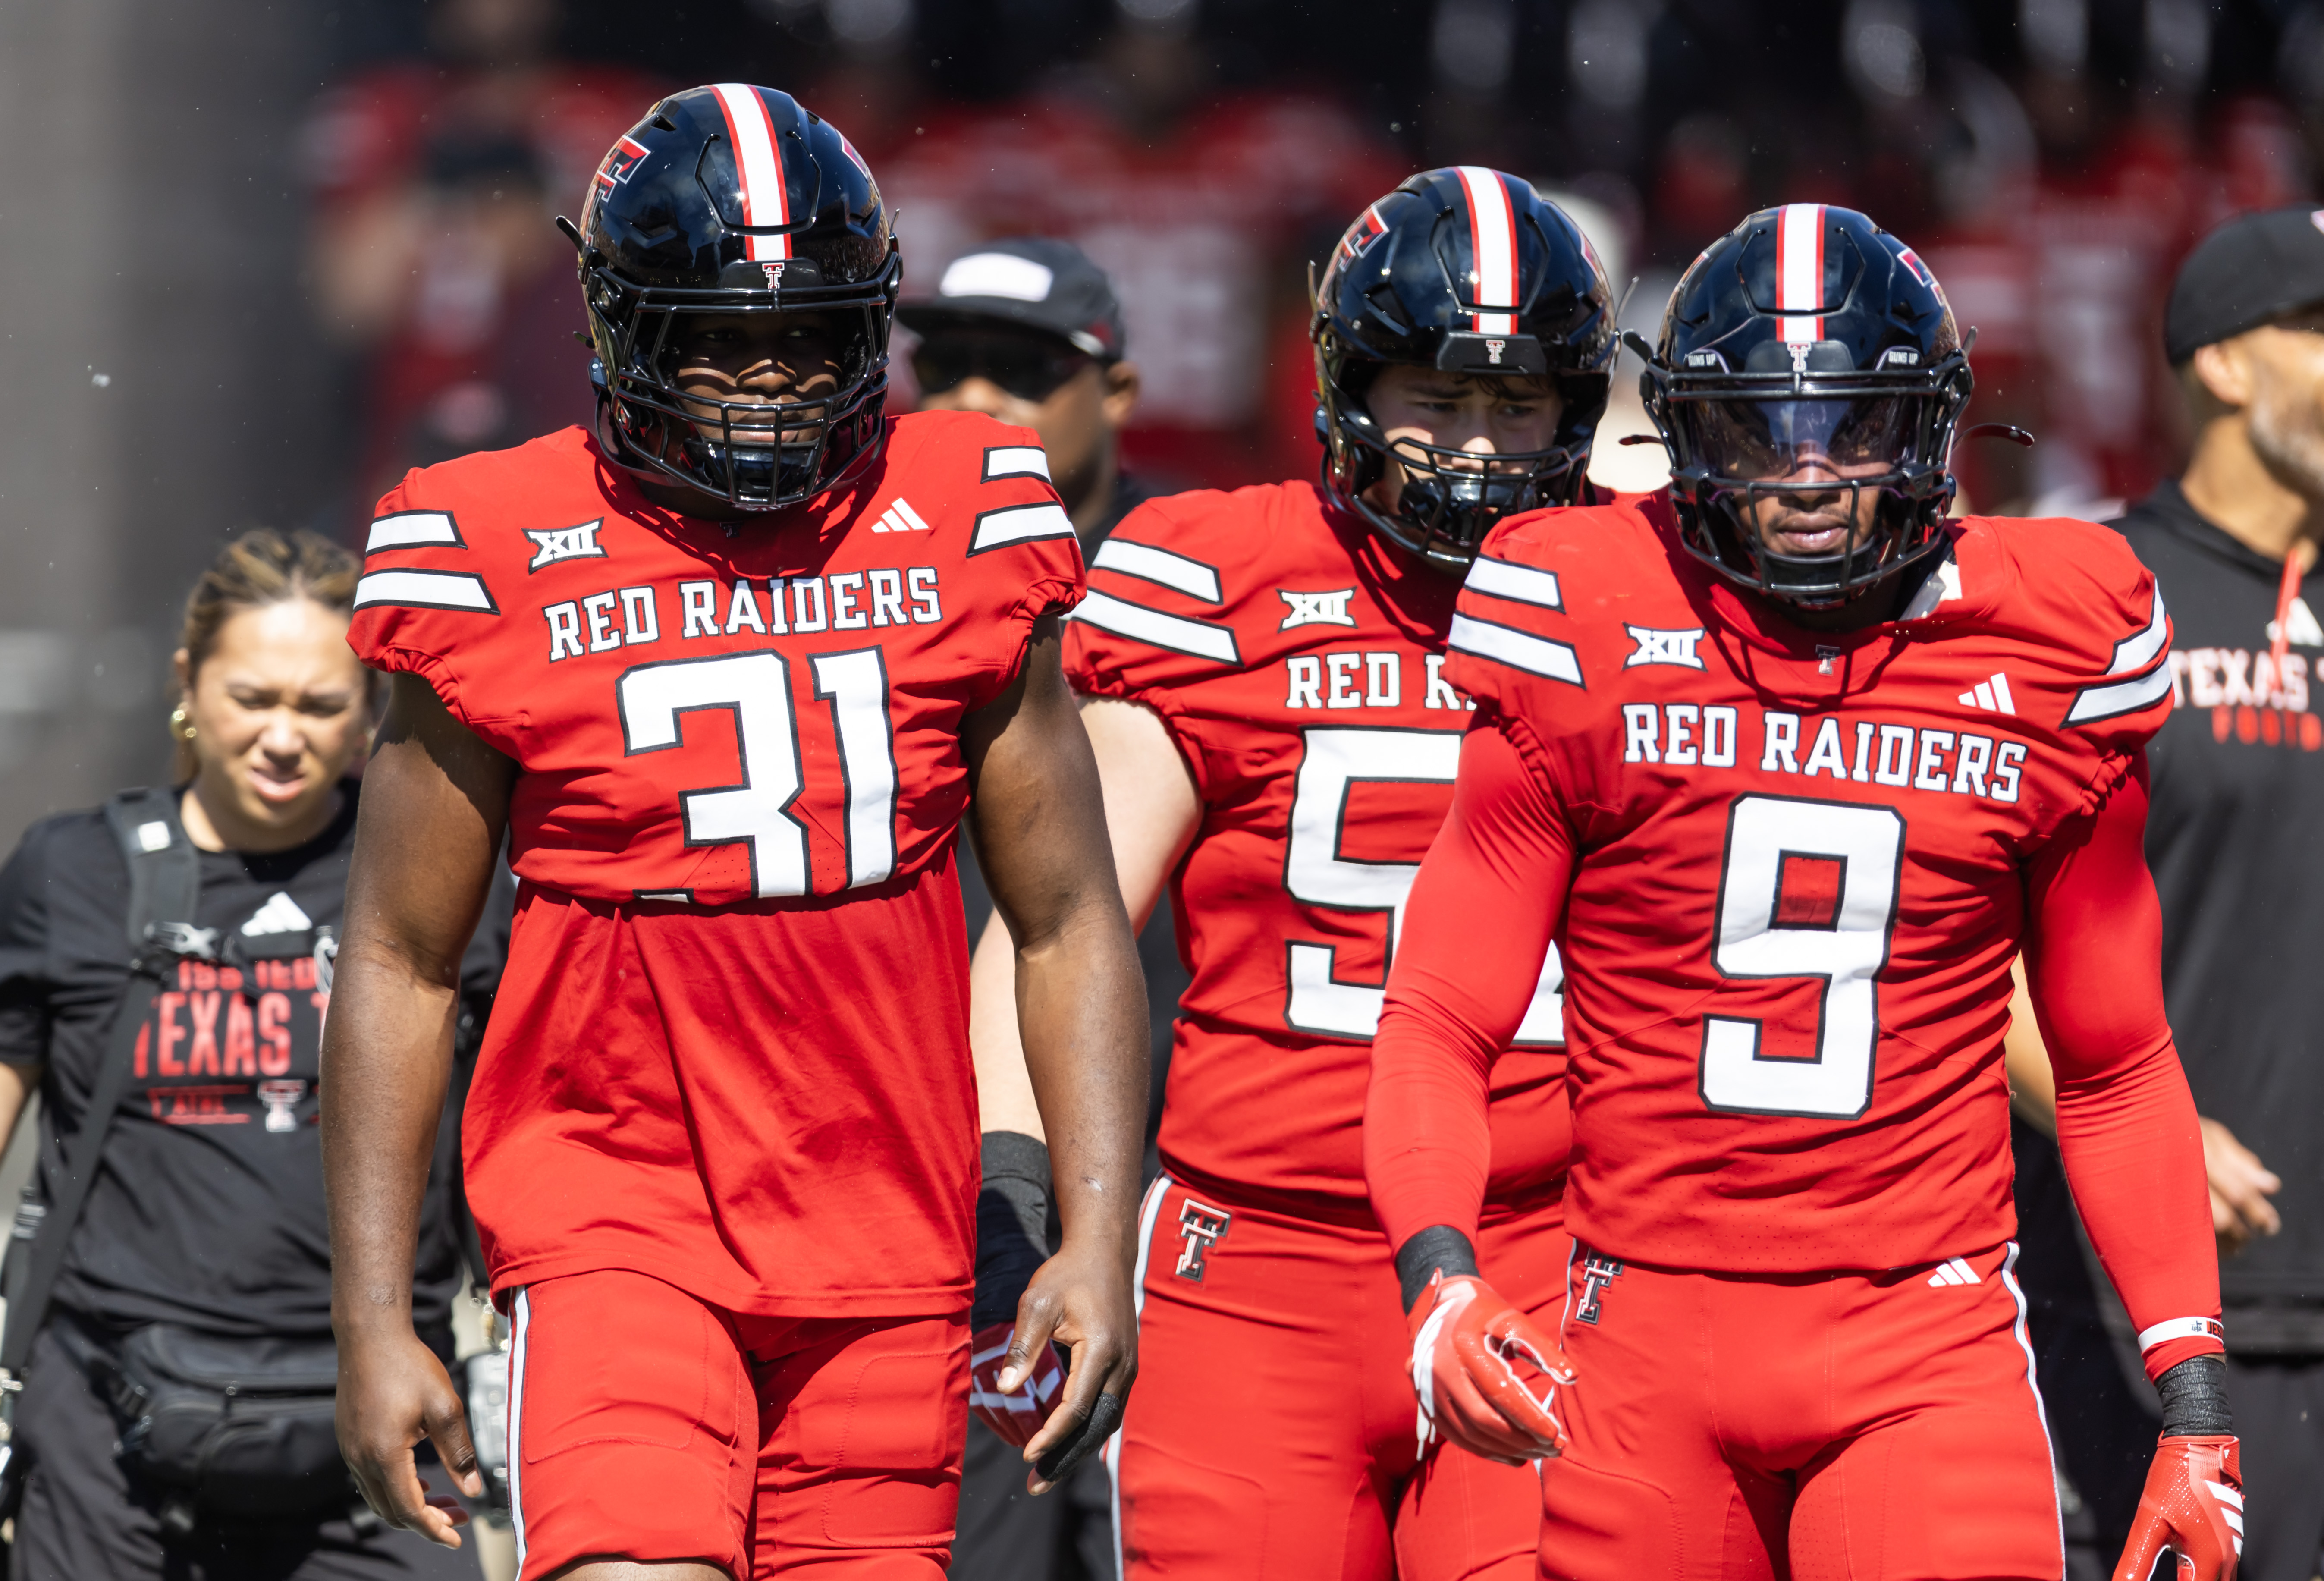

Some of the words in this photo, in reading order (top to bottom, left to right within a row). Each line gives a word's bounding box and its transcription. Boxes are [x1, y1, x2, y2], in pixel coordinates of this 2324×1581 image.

[1688, 355, 1705, 367] GUNS
[1706, 354, 1715, 366] UP
[1889, 351, 1907, 365] GUNS
[1909, 353, 1918, 365] UP
[542, 585, 660, 663] RED
[679, 566, 943, 639] RAIDERS
[1285, 652, 1401, 710] RED
[1423, 652, 1477, 711] R
[615, 645, 898, 902] 31
[1622, 703, 1738, 768] RED
[1761, 710, 2029, 803] RAIDERS
[1698, 791, 1907, 1122] 9
[2207, 1320, 2221, 1338] JES
